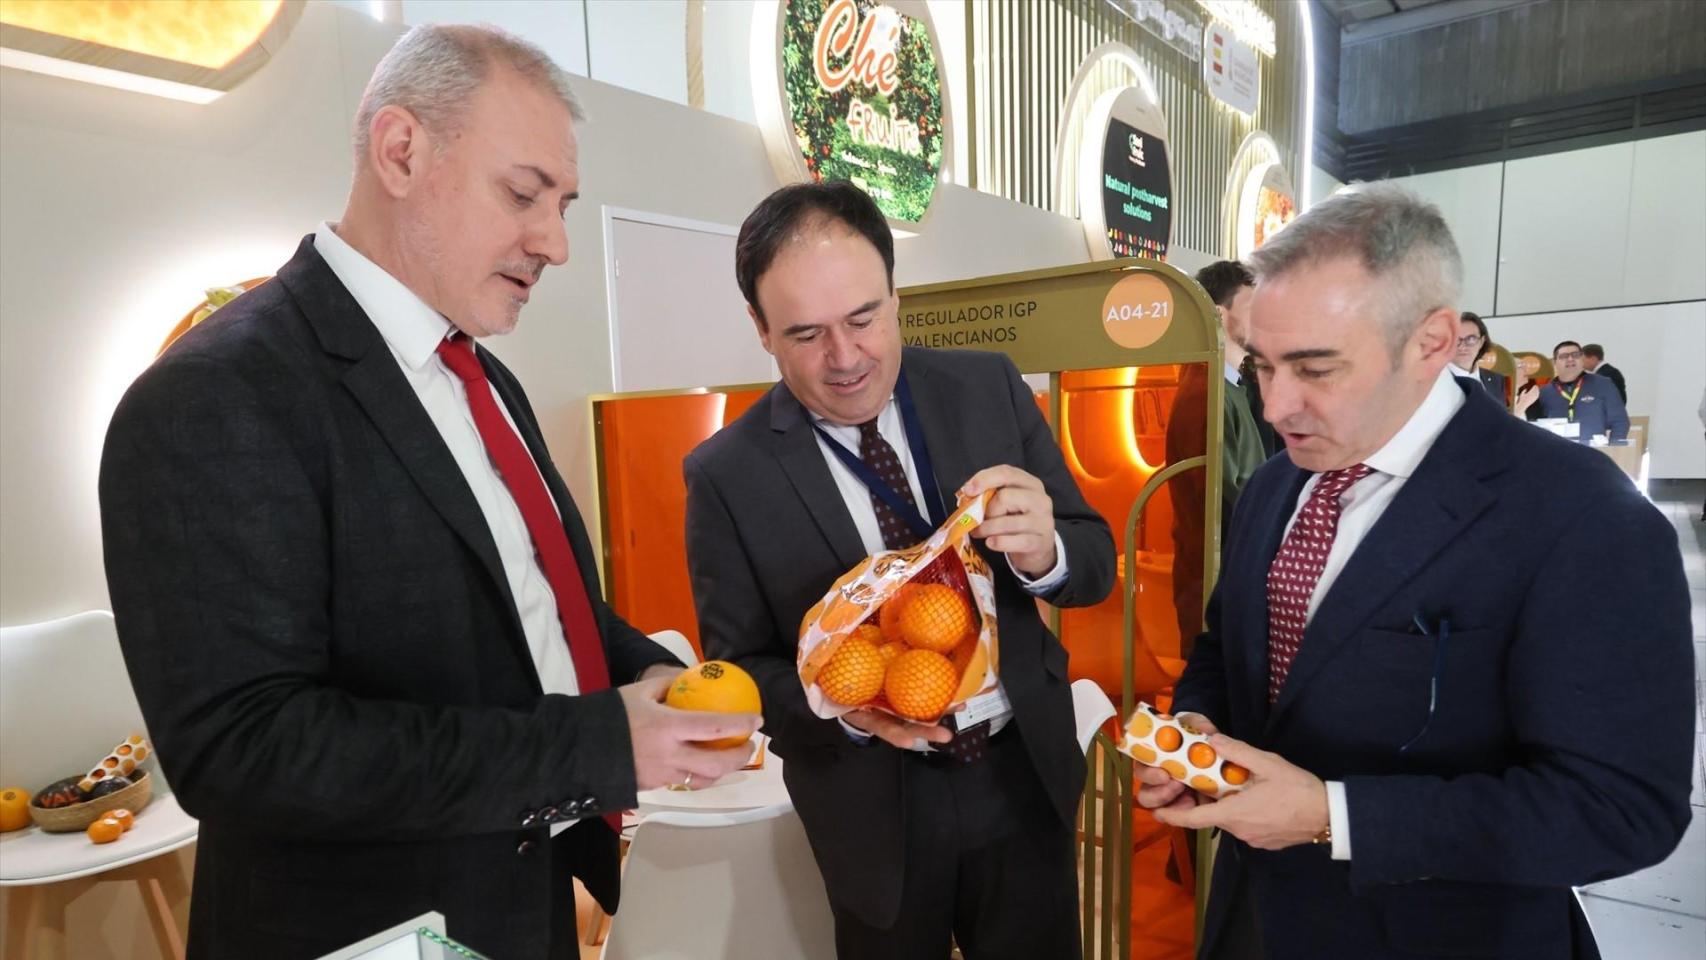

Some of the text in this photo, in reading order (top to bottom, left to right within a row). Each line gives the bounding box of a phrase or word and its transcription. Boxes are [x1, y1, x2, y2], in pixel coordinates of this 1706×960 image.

[815, 0, 901, 93] Ché
[1105, 173, 1131, 196] Natural
[1123, 202, 1152, 222] solutions
[906, 304, 1004, 328] REGULADOR
[1009, 301, 1037, 318] IGP
[1105, 301, 1169, 322] A04-21
[904, 326, 1017, 348] VALENCIANOS
